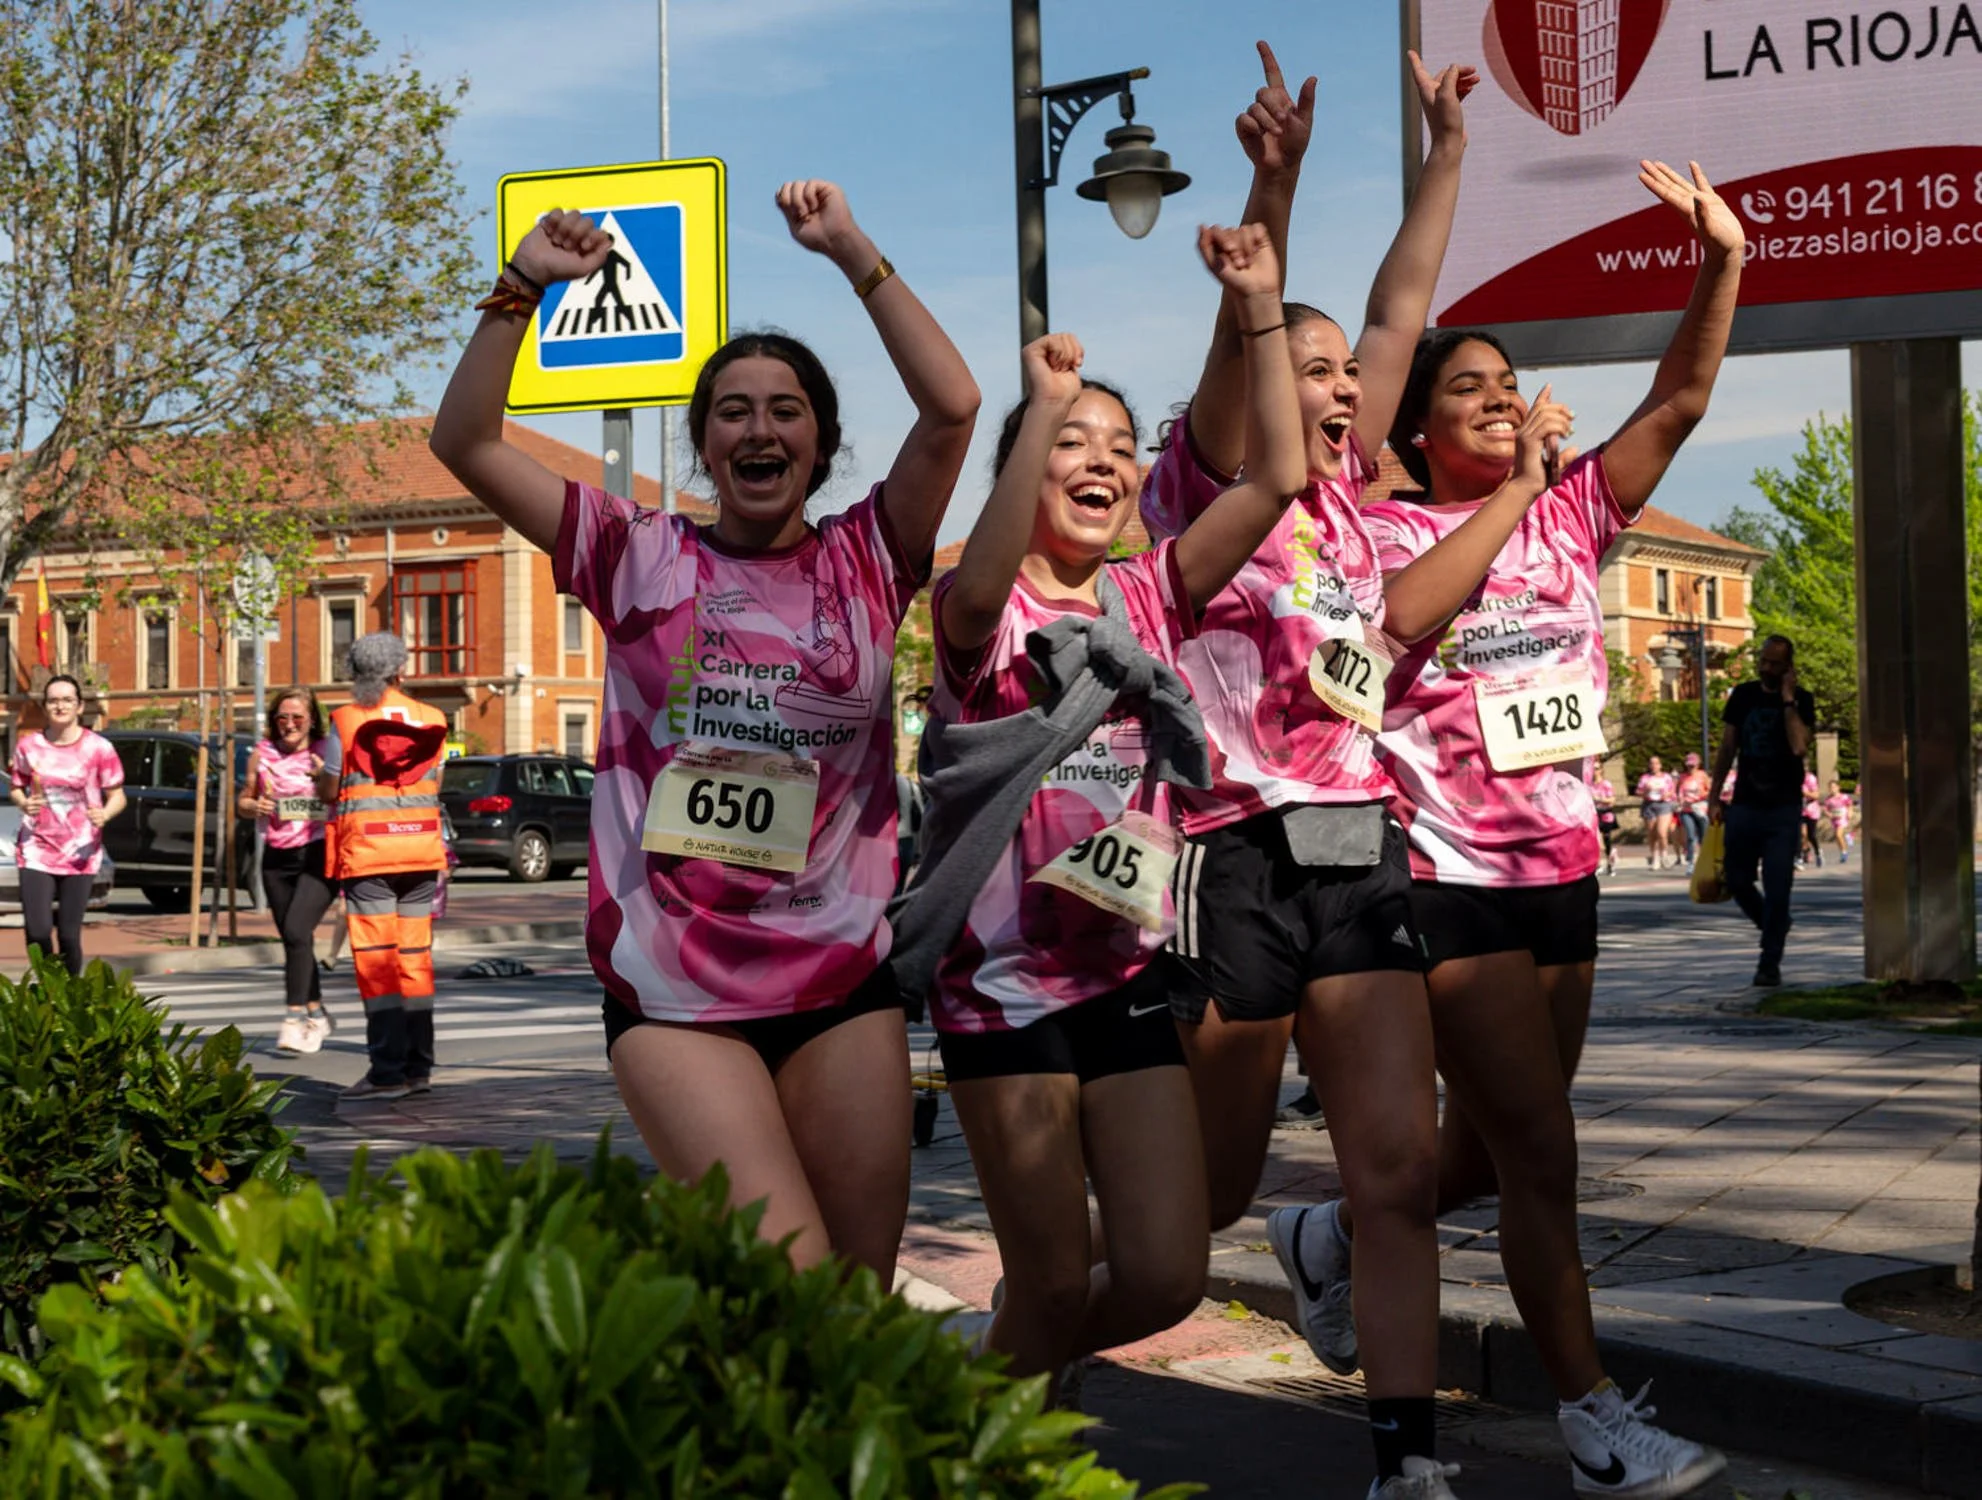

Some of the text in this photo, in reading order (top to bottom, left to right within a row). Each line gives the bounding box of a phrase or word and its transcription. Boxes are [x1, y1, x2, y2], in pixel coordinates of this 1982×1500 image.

[1704, 3, 1982, 80] LA RIOJA
[1784, 182, 1852, 221] 941
[1865, 178, 1904, 214] 21
[1917, 173, 1959, 211] 16
[1596, 221, 1982, 274] www.lpiezaslarioja.c
[1462, 589, 1536, 615] arrera
[702, 628, 725, 648] XI
[1462, 624, 1497, 649] por
[1501, 618, 1523, 636] la
[700, 653, 797, 682] Carrera
[695, 685, 770, 712] por la
[1504, 693, 1583, 740] 1428
[693, 712, 857, 751] Investigación
[686, 778, 774, 834] 650
